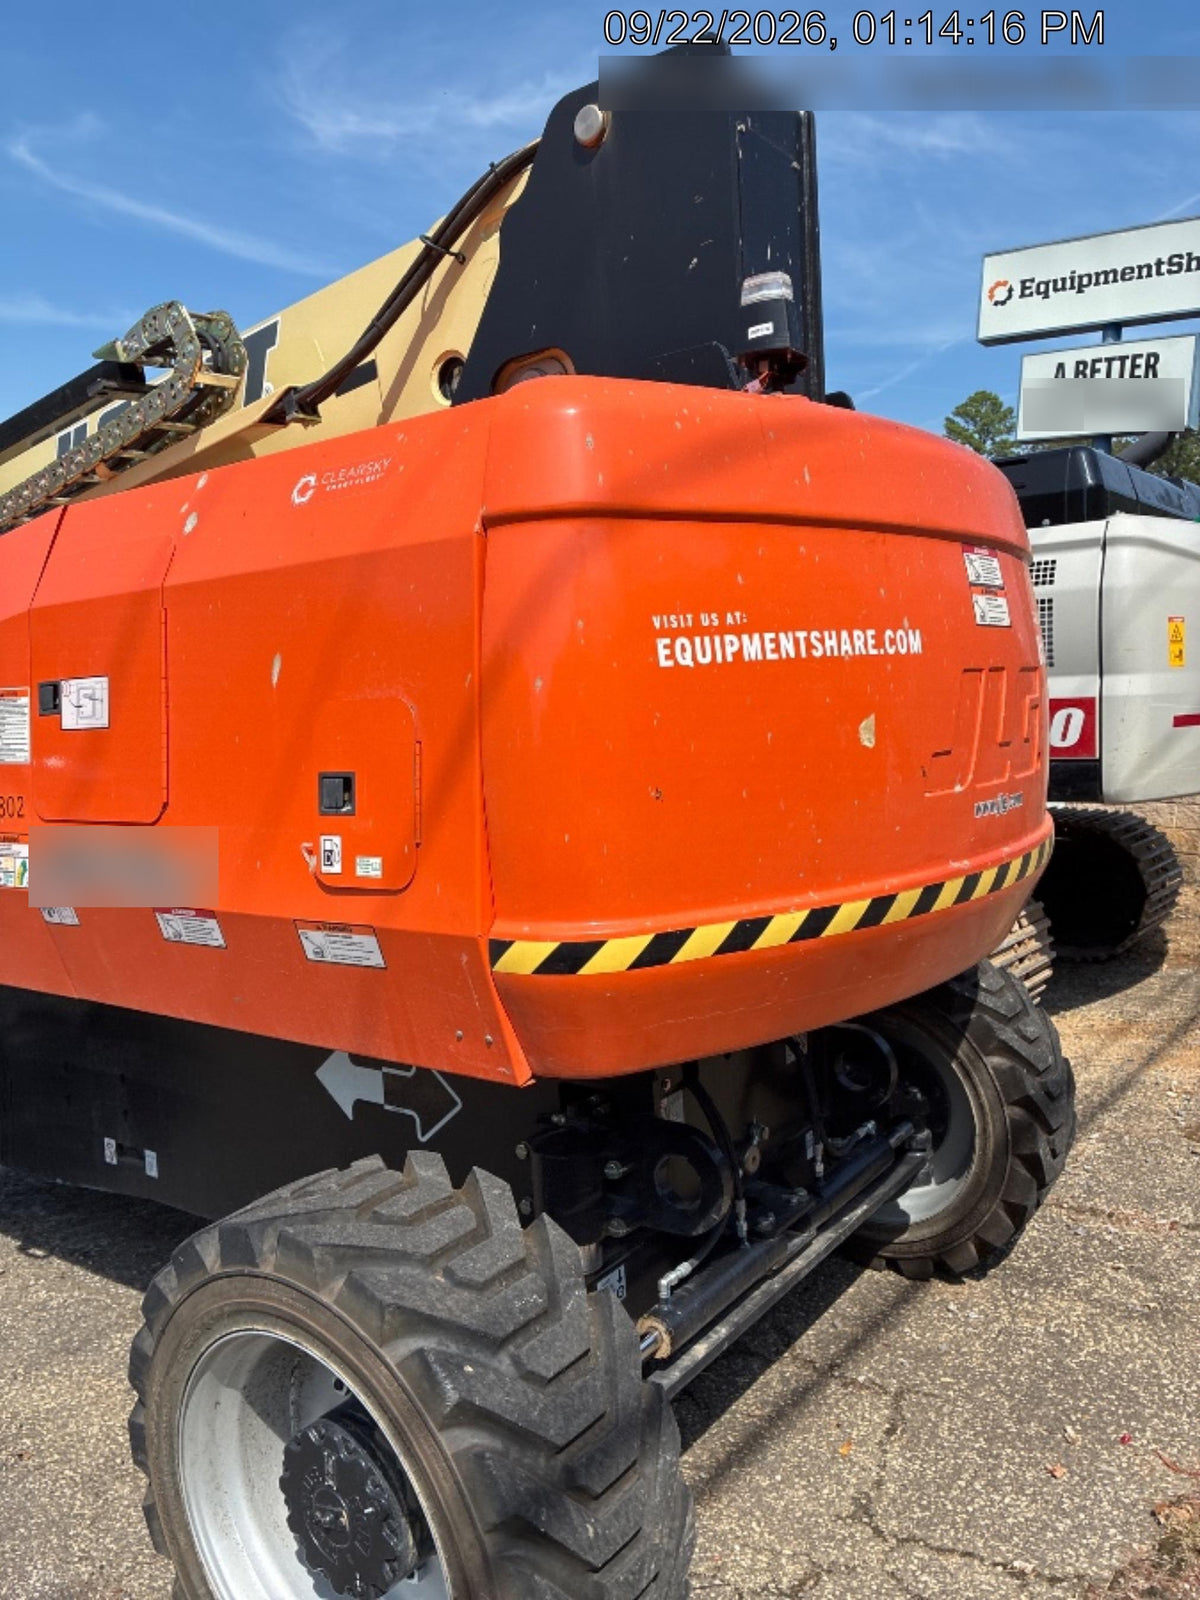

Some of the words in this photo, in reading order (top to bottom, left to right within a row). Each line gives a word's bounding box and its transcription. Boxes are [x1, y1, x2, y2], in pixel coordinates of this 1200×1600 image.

[321, 457, 392, 485] CLEARSKY
[652, 613, 693, 630] VISIT
[701, 612, 719, 627] US
[726, 611, 748, 625] AT:
[656, 628, 922, 668] EQUIPMENTSHARE.COM
